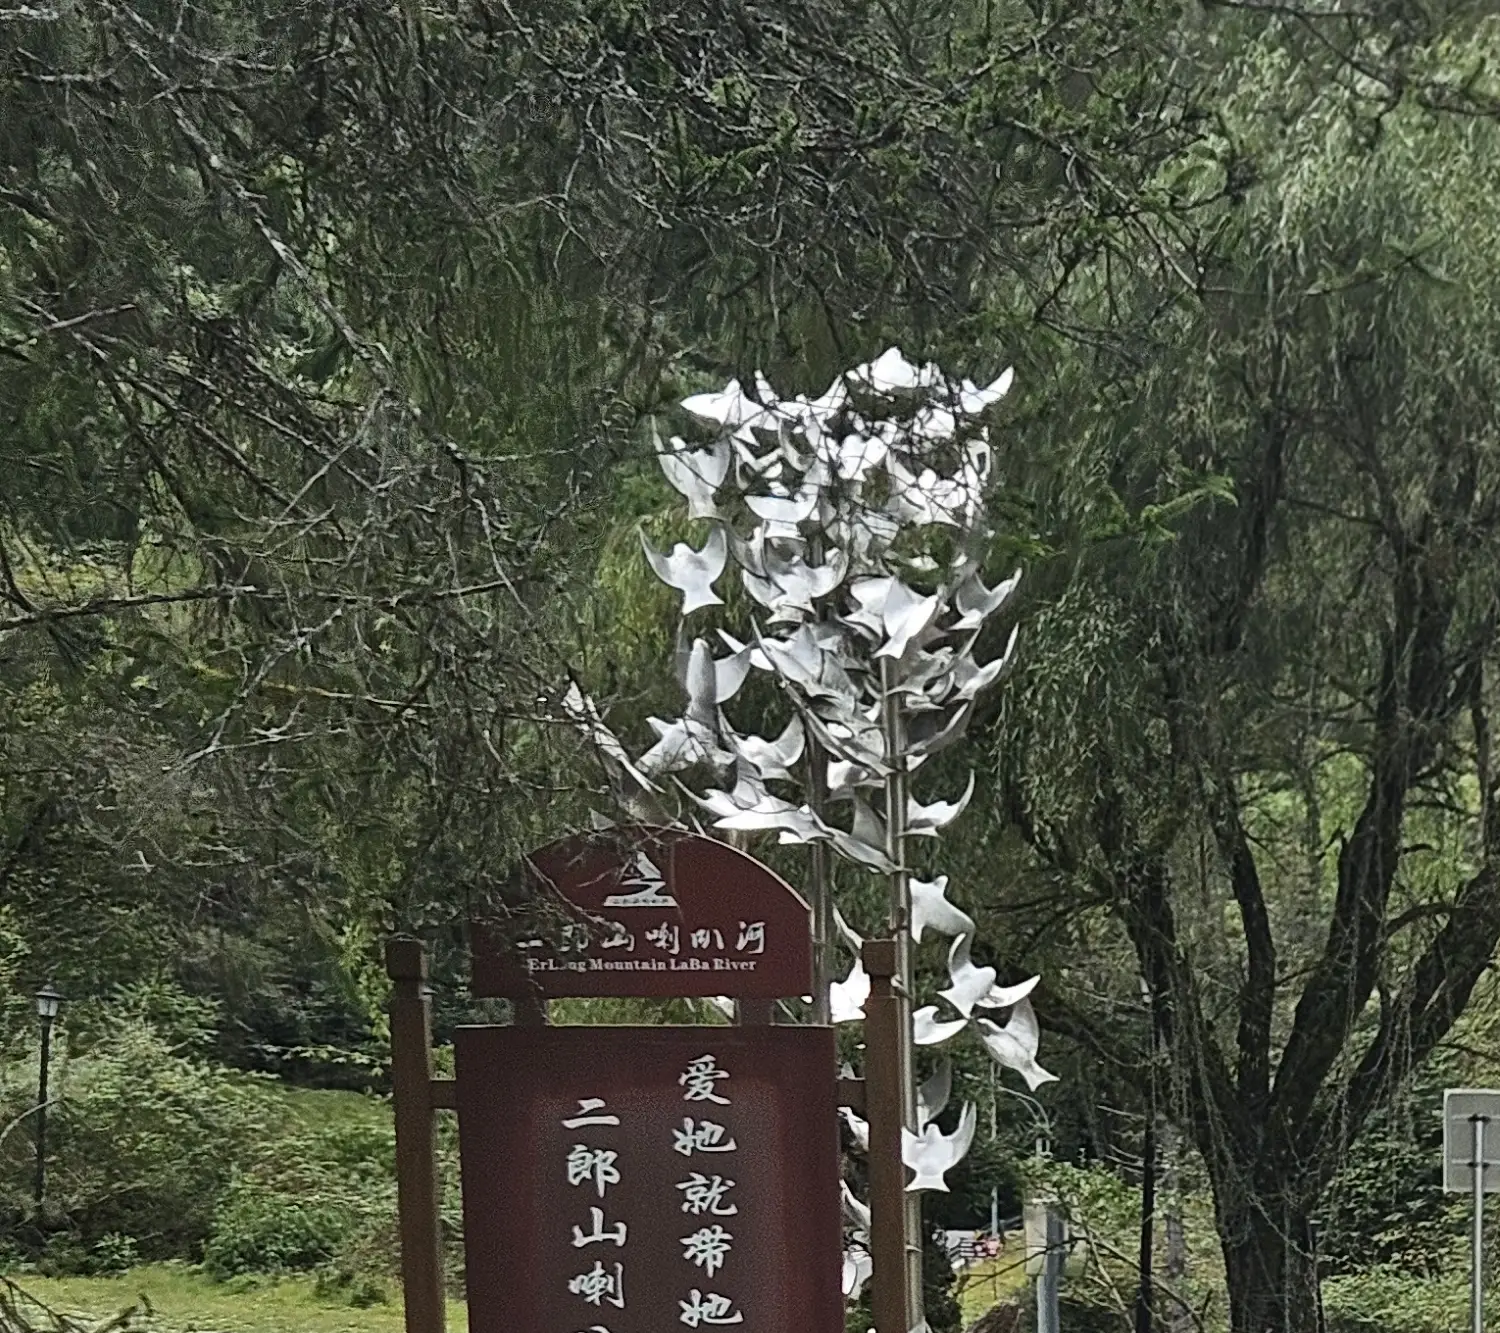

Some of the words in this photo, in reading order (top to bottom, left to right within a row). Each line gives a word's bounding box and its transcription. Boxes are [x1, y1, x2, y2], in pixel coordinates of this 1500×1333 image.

[590, 958, 666, 972] Mountain
[670, 958, 710, 971] LaBa
[714, 958, 756, 971] River
